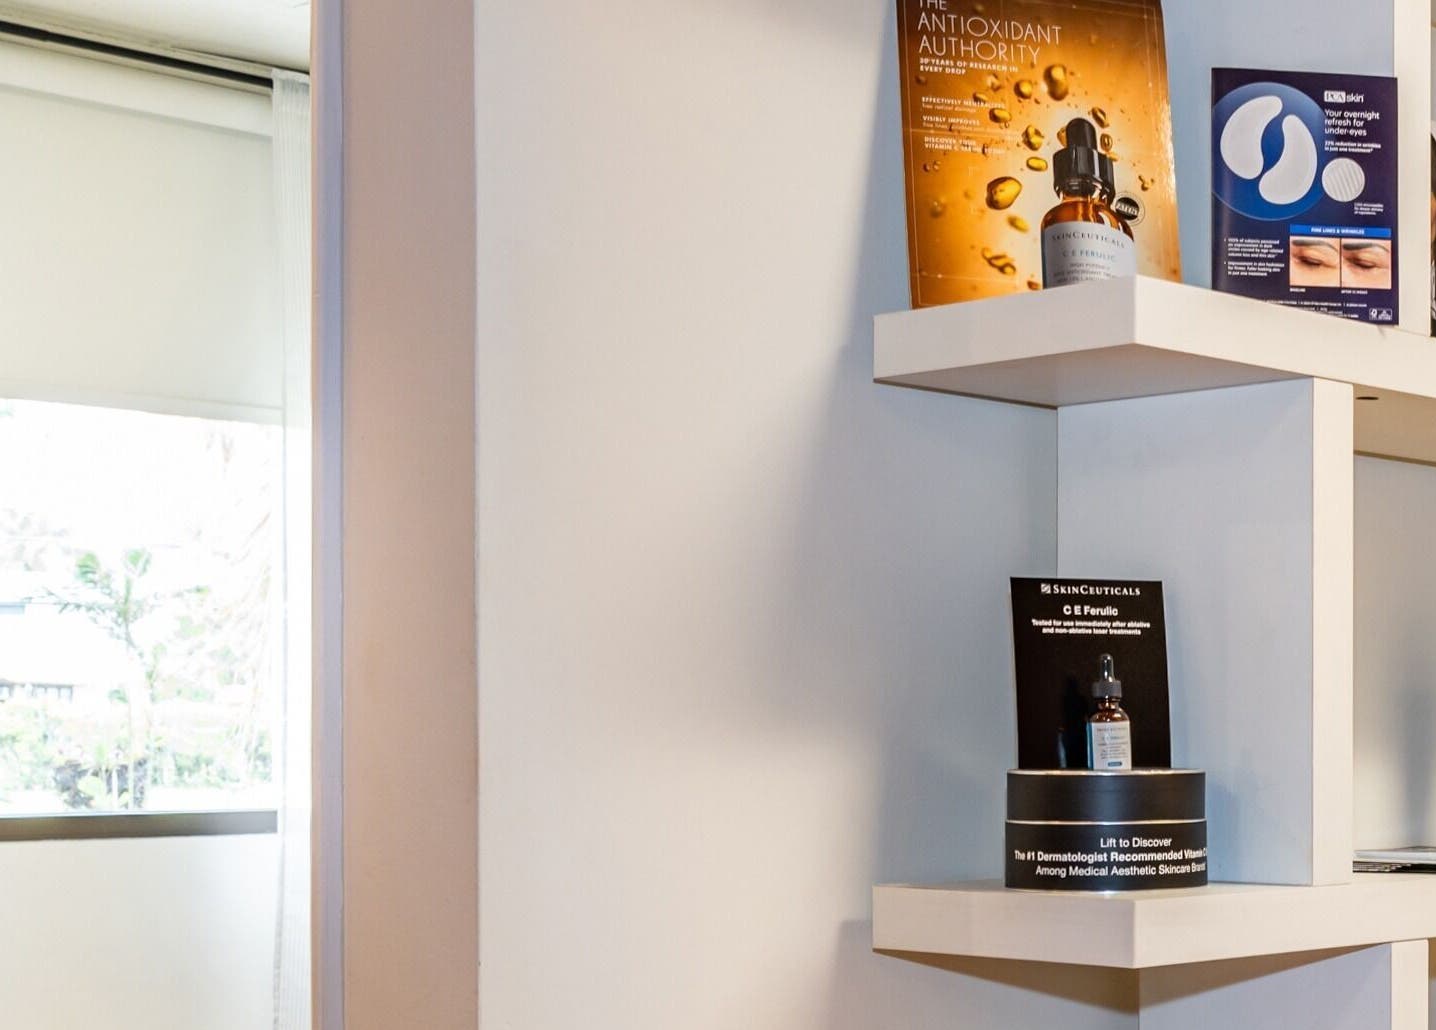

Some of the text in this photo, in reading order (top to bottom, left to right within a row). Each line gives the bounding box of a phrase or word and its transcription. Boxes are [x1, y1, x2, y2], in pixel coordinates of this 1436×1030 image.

[918, 12, 1062, 45] ANTIOXIDANT
[919, 35, 1040, 64] AUTHORITY
[920, 65, 966, 75] EVERY DROP
[932, 58, 954, 66] YEARS
[969, 61, 1007, 71] RESEARCH
[1325, 108, 1380, 121] Your overnight
[1325, 118, 1364, 127] refresh for
[1053, 584, 1141, 596] SKINCEUTICALS
[1063, 605, 1118, 616] C E Ferulic
[1100, 837, 1172, 848] Lift to Discover
[1014, 850, 1026, 861] The
[1027, 851, 1035, 861] #1
[1037, 851, 1108, 865] Dermatologist
[1110, 850, 1183, 862] Recommended
[1036, 865, 1066, 878] Among
[1068, 865, 1108, 877] Medical
[1111, 865, 1156, 876] Aesthetic
[1158, 863, 1190, 875] Skincare
